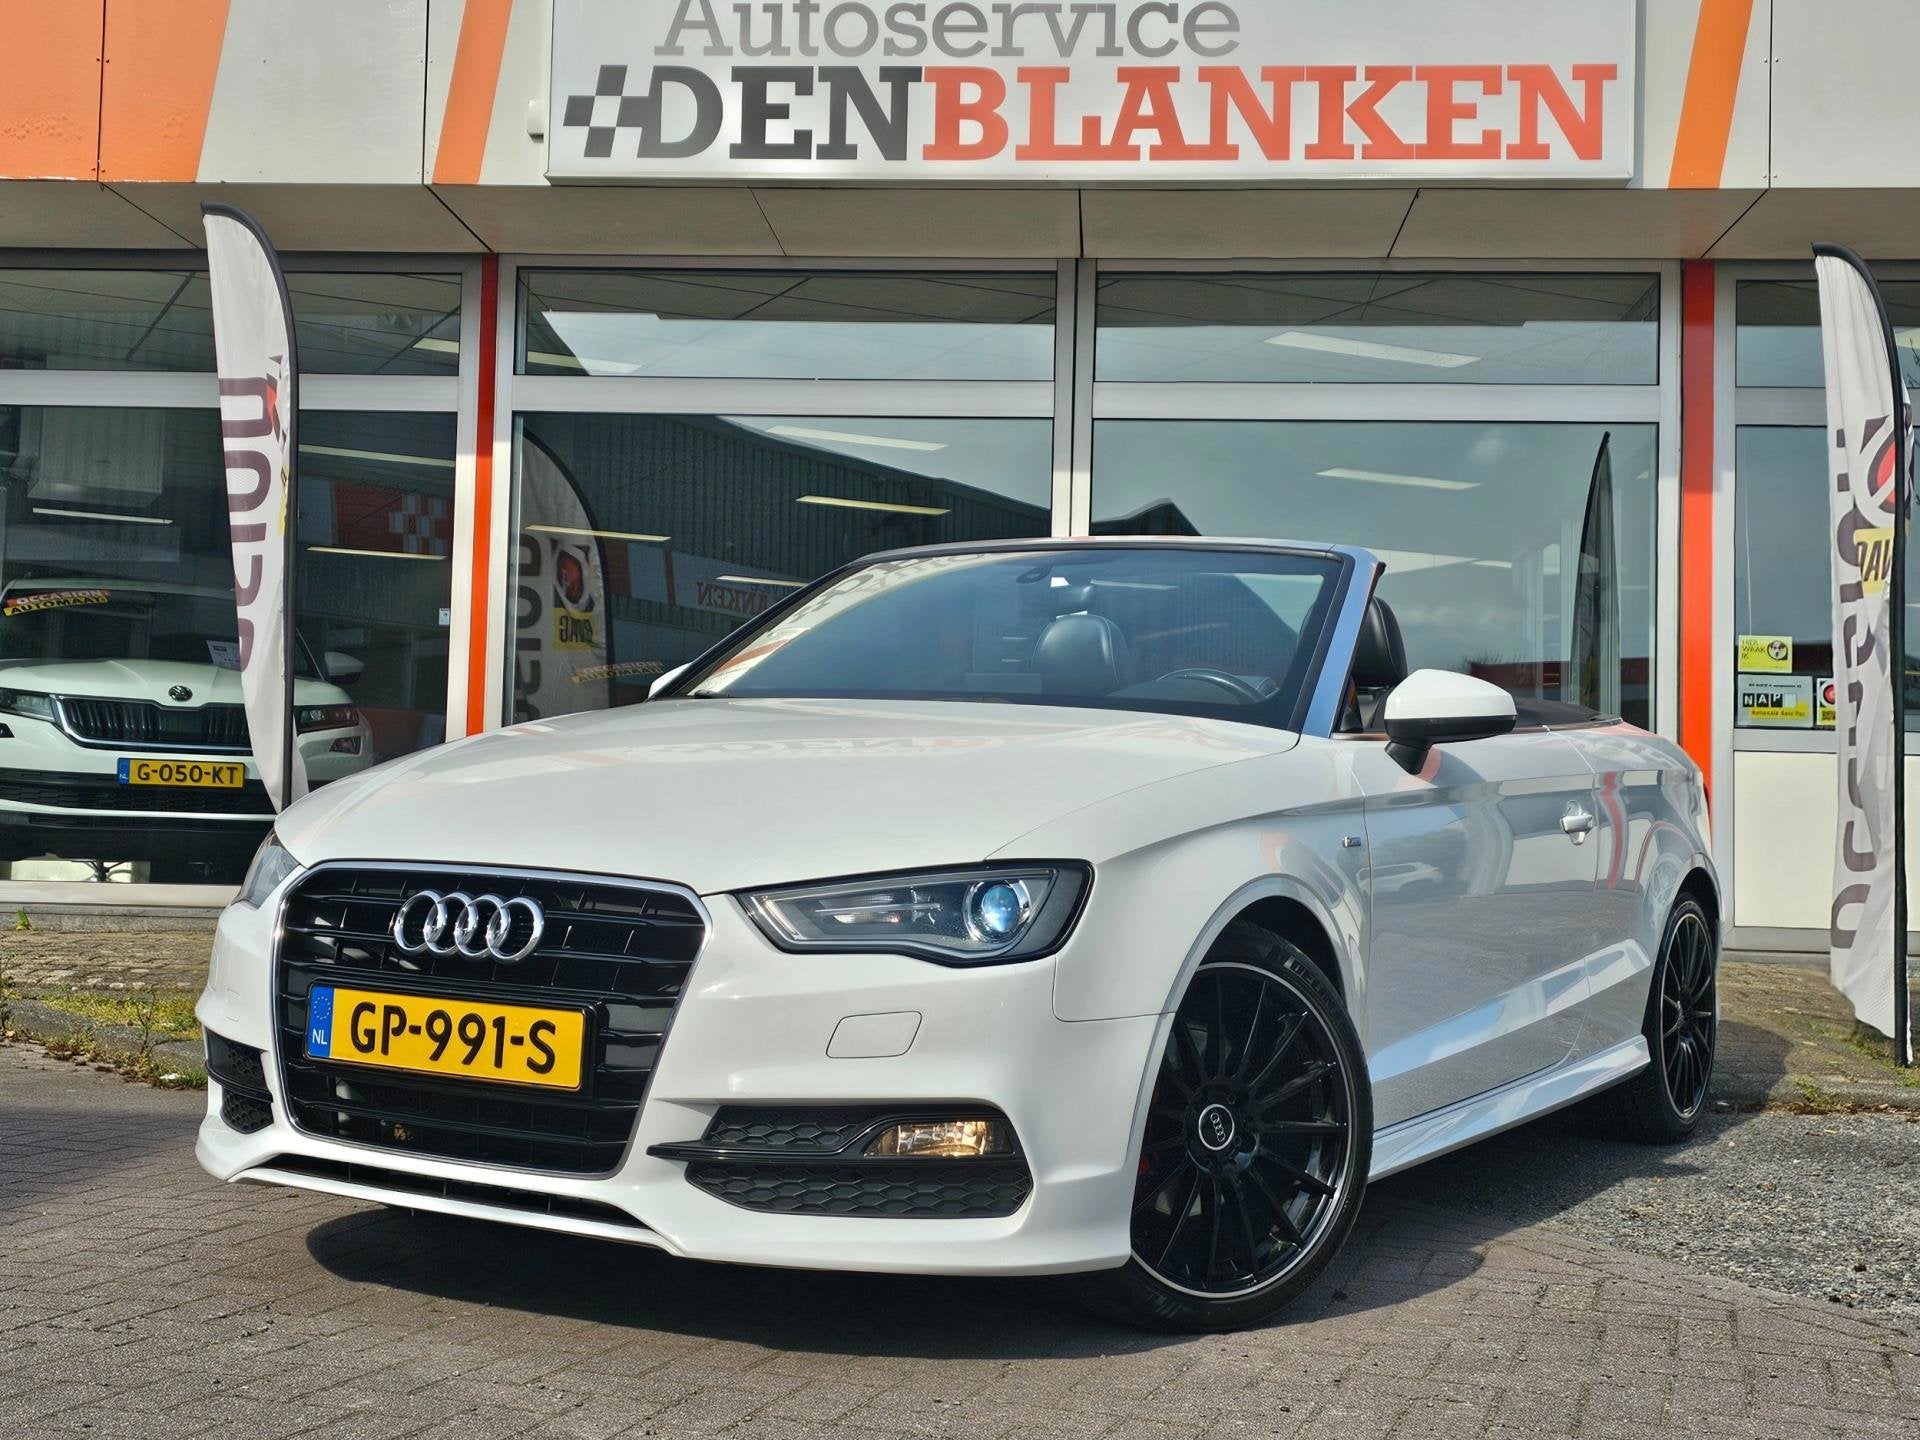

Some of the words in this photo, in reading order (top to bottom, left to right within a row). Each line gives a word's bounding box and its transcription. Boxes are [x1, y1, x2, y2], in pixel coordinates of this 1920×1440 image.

[654, 0, 1241, 57] Autoservice
[11, 597, 102, 614] AUTOMAAT
[16, 590, 101, 605] OCCASION
[1744, 693, 1782, 706] NAP
[137, 762, 237, 785] G-050-KT
[312, 1029, 328, 1046] NL
[350, 1001, 556, 1074] GP-991-S
